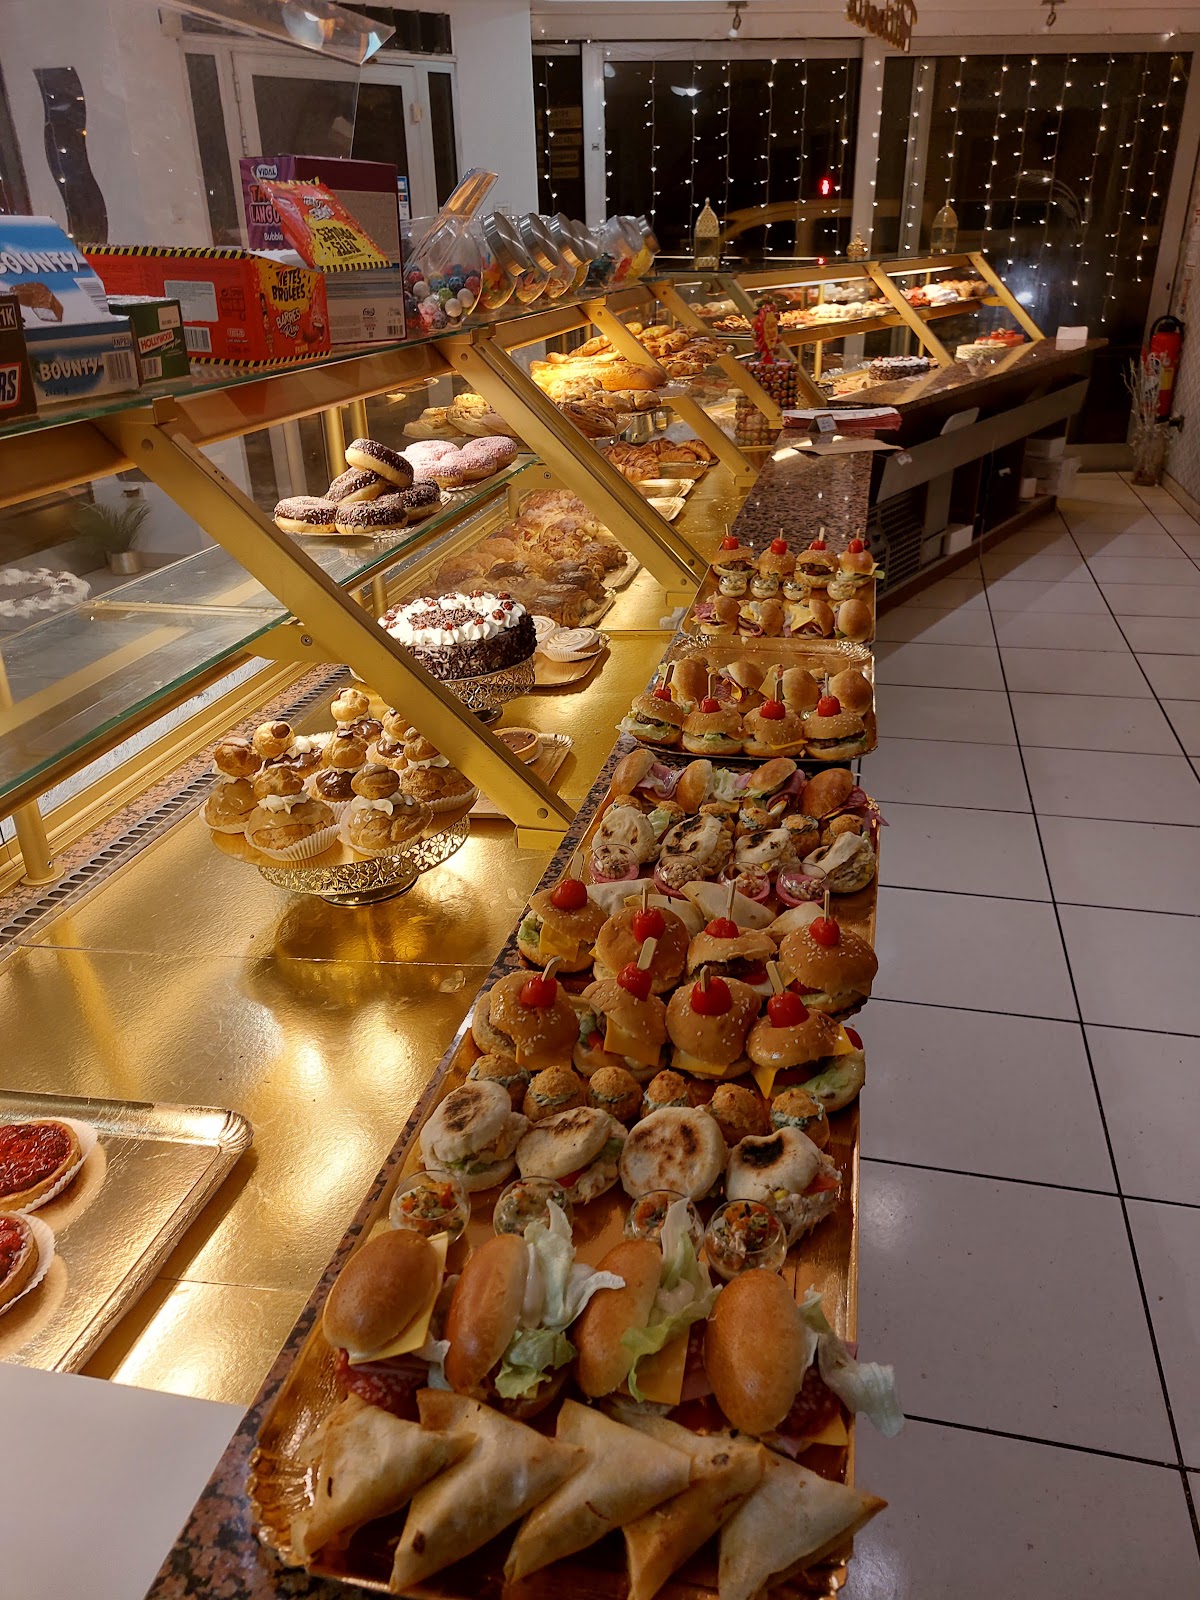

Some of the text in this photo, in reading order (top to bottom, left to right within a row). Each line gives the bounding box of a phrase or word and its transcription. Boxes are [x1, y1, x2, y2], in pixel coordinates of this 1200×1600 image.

[258, 167, 277, 177] VIDAL
[263, 232, 284, 242] Bubble
[276, 308, 301, 328] BARRES
[140, 331, 173, 350] HOLLYWOOD
[39, 357, 99, 382] BOUNTY
